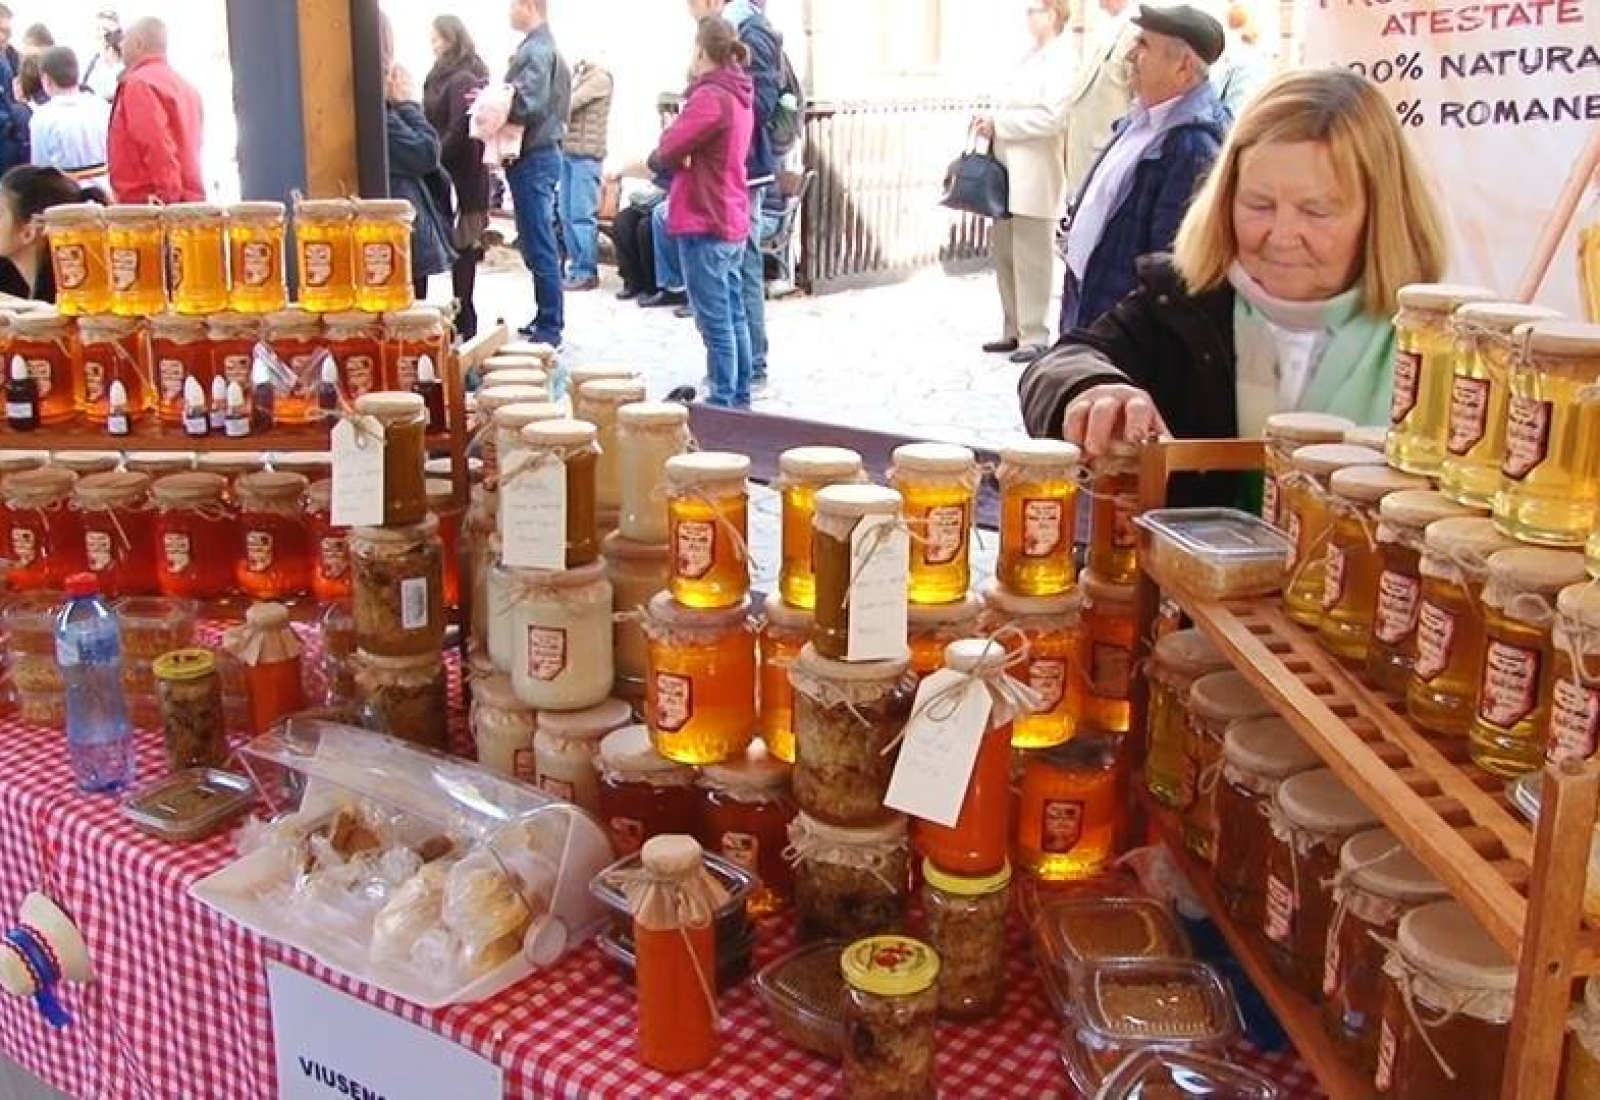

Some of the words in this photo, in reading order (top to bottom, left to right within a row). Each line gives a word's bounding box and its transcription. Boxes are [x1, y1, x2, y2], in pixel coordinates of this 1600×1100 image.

[1381, 0, 1584, 36] ATESTATE
[1440, 95, 1600, 128] ROMANE
[298, 1055, 386, 1100] VIUSEN
